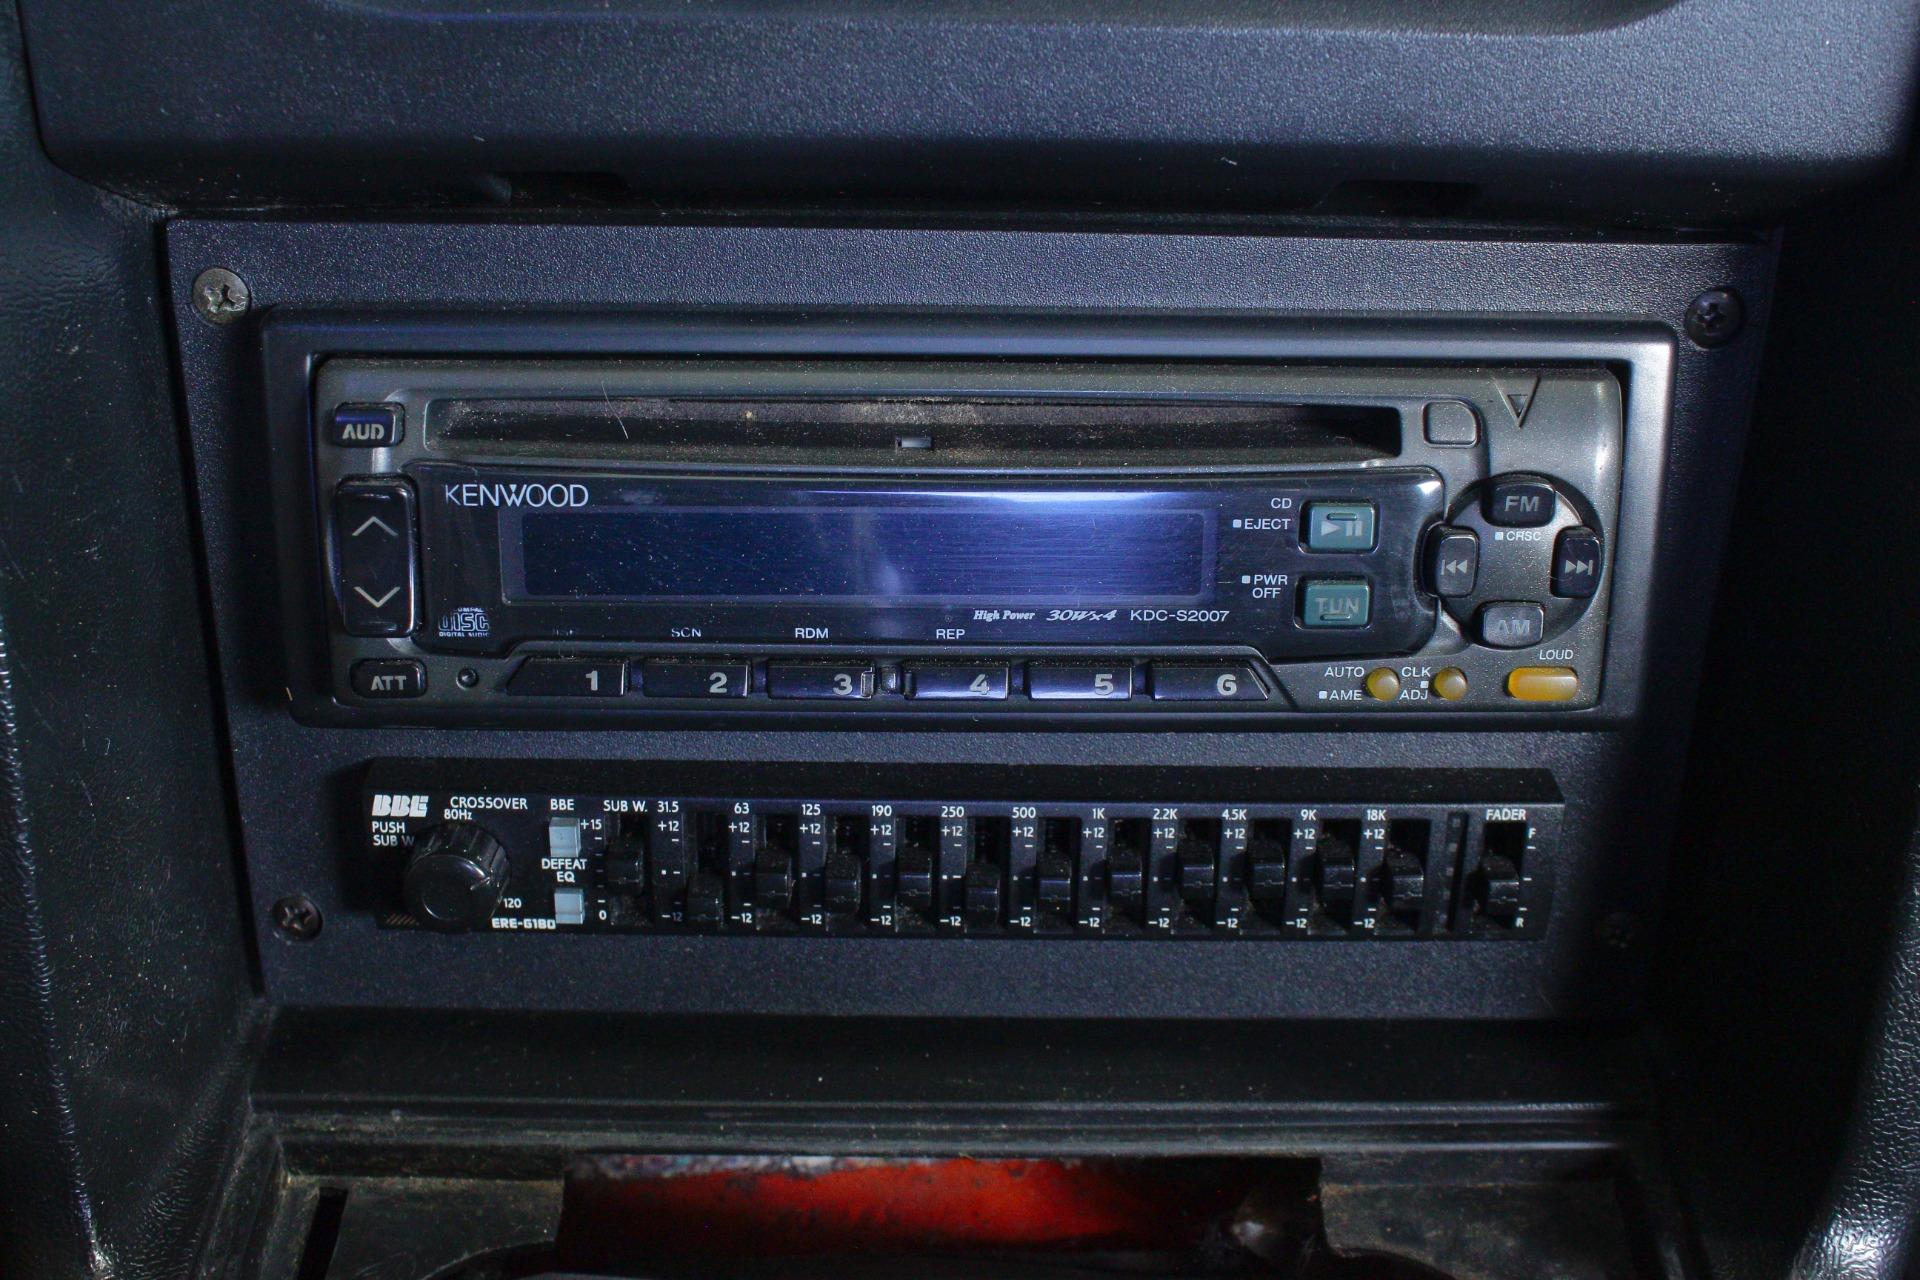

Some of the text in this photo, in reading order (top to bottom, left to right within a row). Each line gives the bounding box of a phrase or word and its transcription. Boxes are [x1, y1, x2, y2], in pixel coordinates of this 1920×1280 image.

[342, 423, 385, 440] AUD
[444, 483, 589, 508] KENWOOD
[1271, 497, 1292, 510] CD
[1505, 496, 1539, 513] FM
[1245, 518, 1291, 532] EJECT
[1506, 531, 1542, 543] CRSC
[1254, 573, 1288, 587] PWR
[1252, 587, 1282, 600] OFF
[1316, 598, 1359, 615] TUN
[973, 610, 1000, 621] High
[1002, 610, 1036, 621] Power
[1130, 610, 1230, 623] KDC-S2007
[671, 627, 702, 638] SCN
[795, 627, 829, 639] RDM
[936, 628, 966, 640] REP
[1539, 650, 1574, 661] LOUD
[1324, 666, 1365, 679] AUTO
[1401, 666, 1432, 679] CLK
[370, 674, 407, 691] ATT
[586, 670, 599, 691] 1
[708, 672, 728, 693] 2
[832, 674, 853, 695] 3
[969, 674, 990, 695] 4
[1093, 673, 1115, 694] 5
[1216, 674, 1238, 695] 6
[1329, 689, 1363, 701] AME
[1400, 689, 1429, 701] ADJ
[372, 795, 429, 818] BBE
[450, 796, 528, 811] CROSSOVER
[550, 799, 575, 811] BBE
[603, 800, 648, 812] SUB W.
[657, 801, 680, 813] 31.5
[734, 803, 750, 815] 63
[443, 808, 473, 820] 80Hz
[801, 804, 821, 816] 125
[872, 805, 892, 817] 190
[941, 806, 965, 818] 250
[1012, 807, 1037, 819] 500
[1092, 808, 1105, 820] 1K
[1153, 808, 1178, 820] 2.2K
[1221, 808, 1247, 821] 4.5K
[1300, 809, 1317, 821] 9K
[1366, 809, 1387, 821] 18K
[1486, 809, 1527, 821] FADER
[372, 821, 406, 833] PUSH
[581, 818, 602, 830] +15
[658, 821, 680, 832] +12
[728, 822, 750, 833] +12
[799, 823, 821, 834] +12
[870, 824, 892, 836] +12
[941, 826, 963, 837] +12
[1012, 826, 1034, 837] +12
[1083, 827, 1105, 838] +12
[1153, 827, 1175, 838] +12
[1224, 828, 1246, 839] +12
[1293, 828, 1316, 839] +12
[1363, 828, 1385, 840] +12
[1528, 827, 1537, 839] F
[373, 834, 398, 847] SUB
[541, 858, 588, 871] DEFEAT
[556, 871, 576, 884] EQ
[503, 898, 522, 909] 120
[598, 910, 607, 921] 0
[731, 912, 753, 924] -12
[801, 914, 823, 925] -12
[870, 915, 892, 926] -12
[939, 915, 962, 926] -12
[1010, 916, 1032, 927] -12
[1079, 917, 1101, 928] -12
[1149, 917, 1171, 928] -12
[1217, 917, 1239, 928] -12
[1286, 918, 1308, 929] -12
[1353, 918, 1376, 929] -12
[1515, 917, 1525, 928] R
